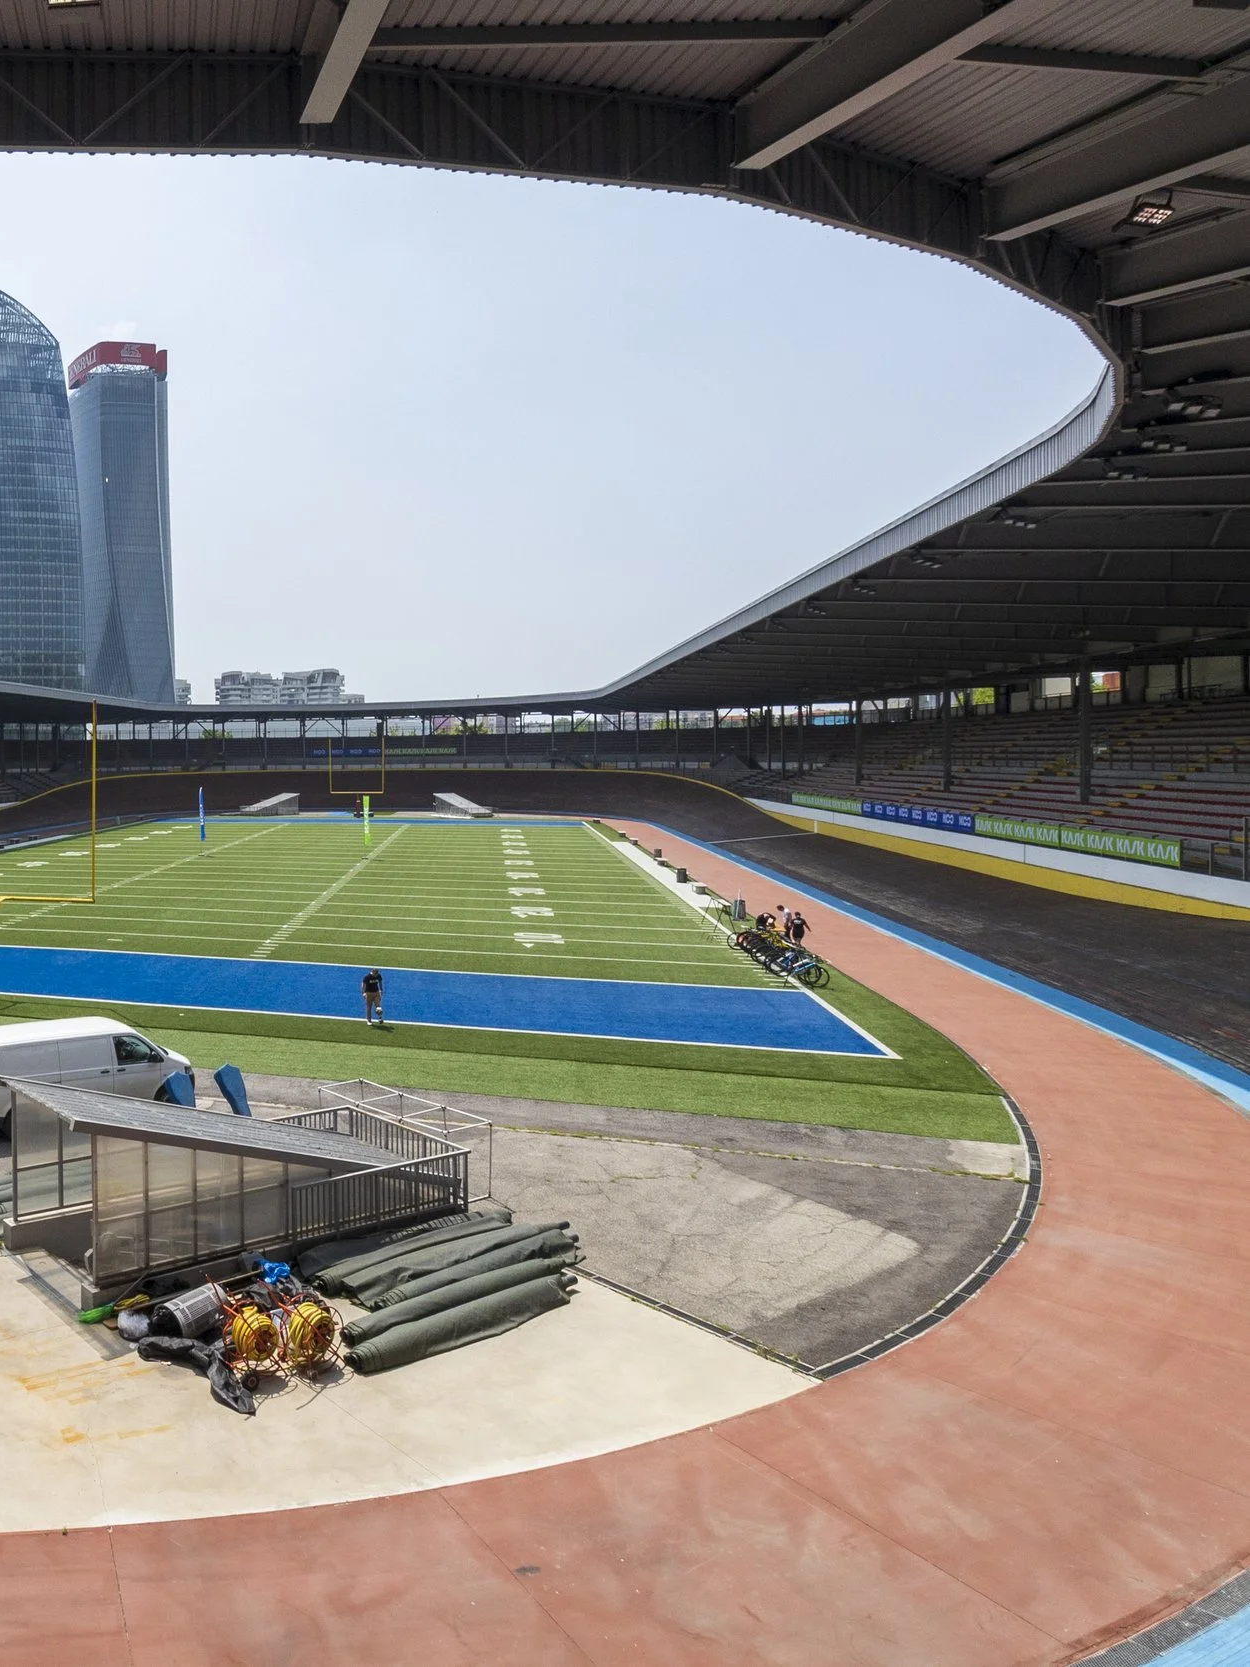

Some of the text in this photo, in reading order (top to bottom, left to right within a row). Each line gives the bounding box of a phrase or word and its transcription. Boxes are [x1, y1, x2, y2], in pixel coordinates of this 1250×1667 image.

[1087, 834, 1114, 852] KASK
[1116, 838, 1145, 856] KASK
[1148, 842, 1179, 862] KASK
